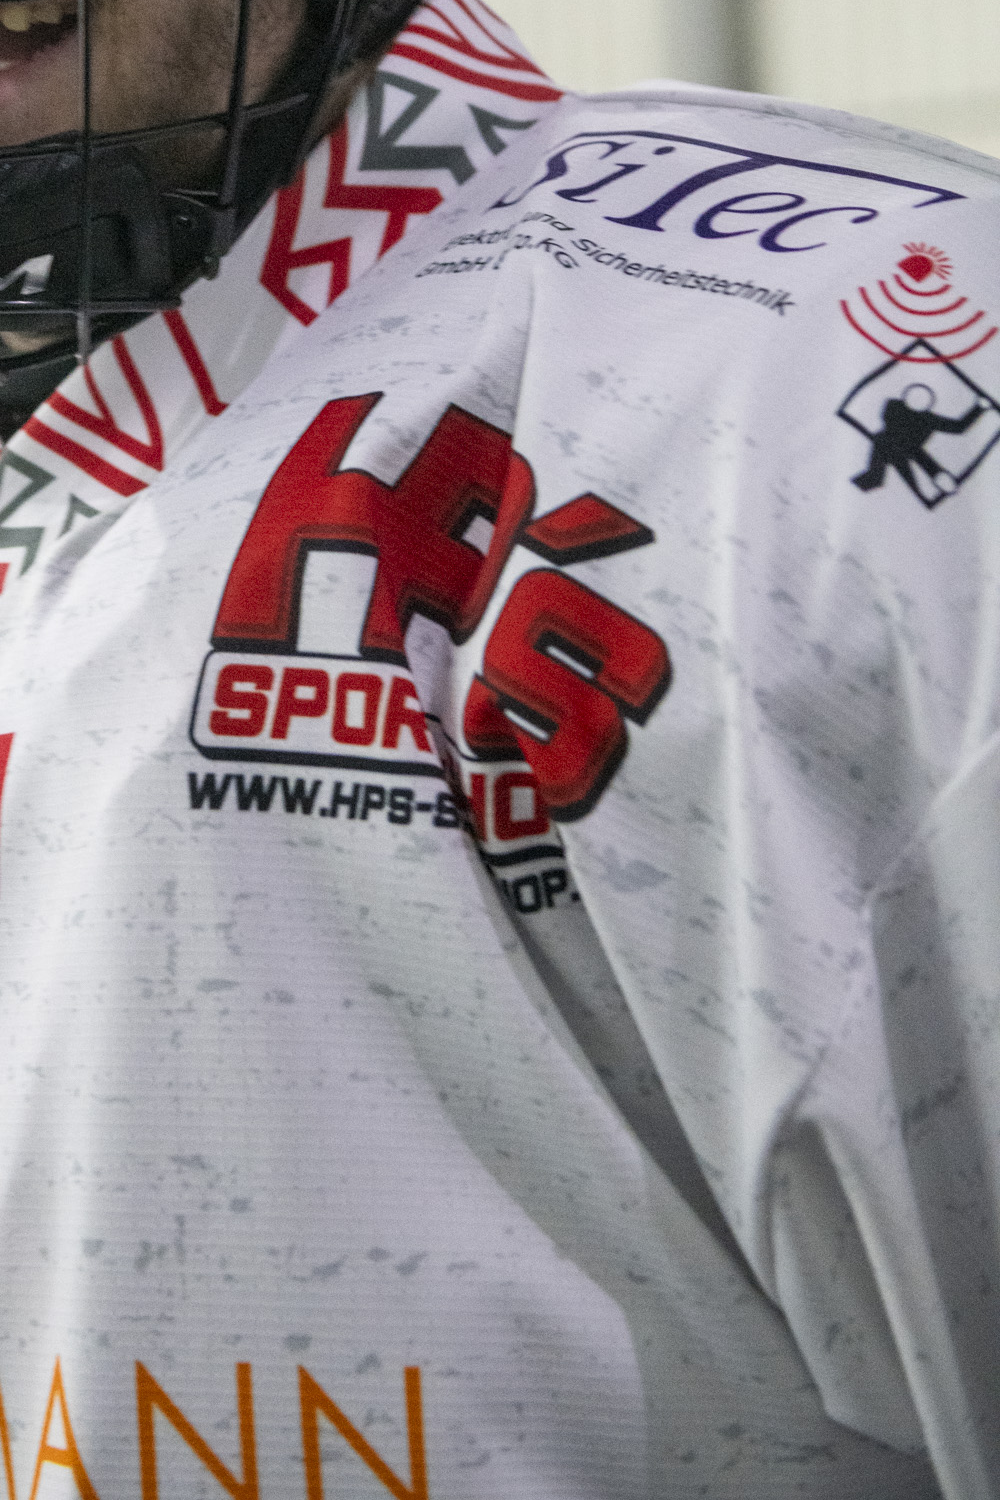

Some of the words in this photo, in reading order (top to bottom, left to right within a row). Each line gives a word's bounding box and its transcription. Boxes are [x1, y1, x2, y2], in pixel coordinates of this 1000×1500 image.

[486, 130, 968, 253] SiTec
[570, 237, 797, 317] Sicherheitstechnik
[208, 663, 436, 754] SPOR
